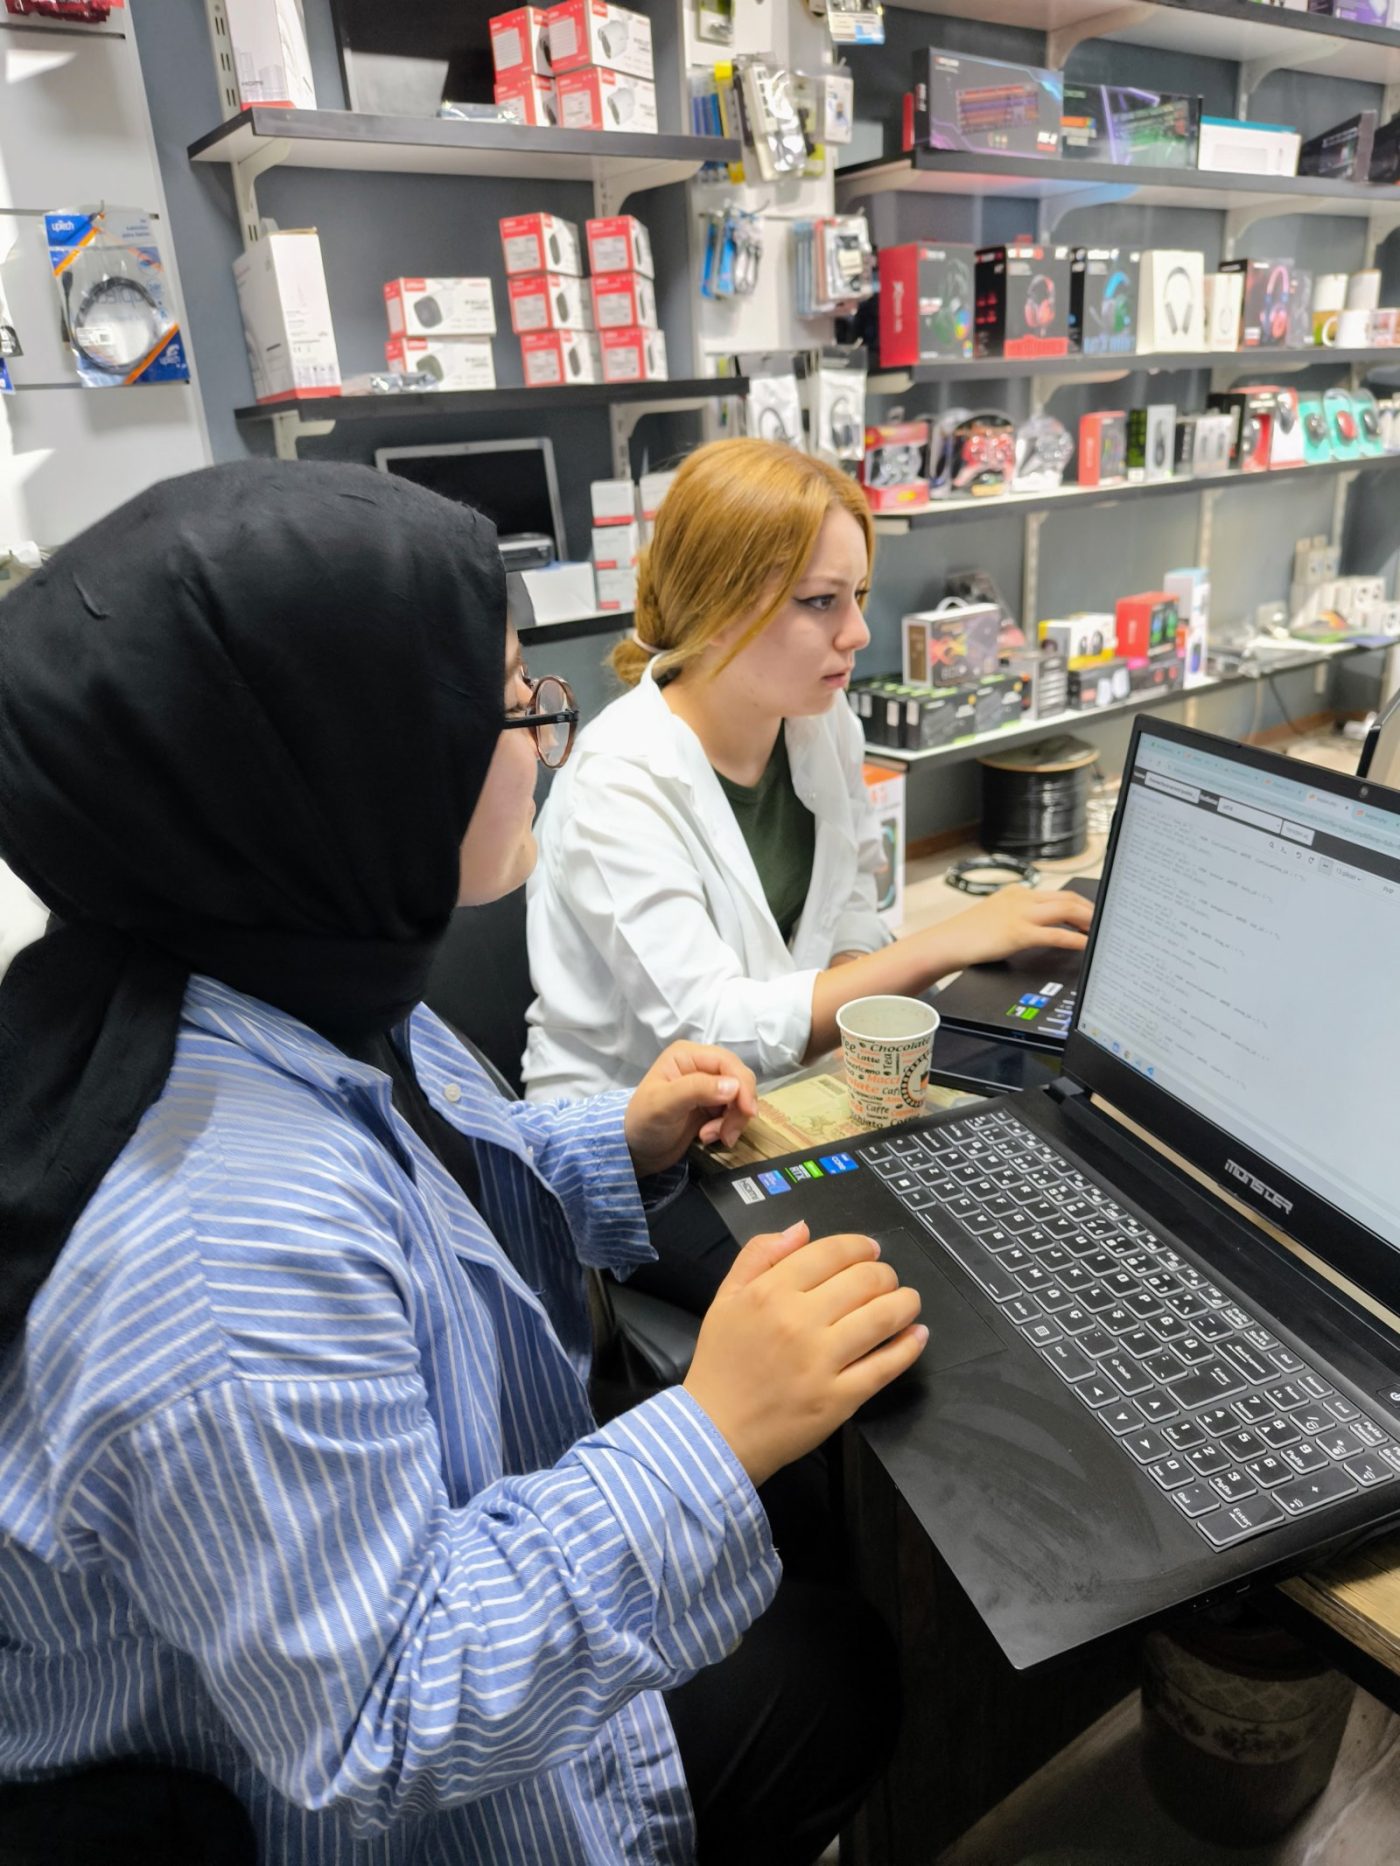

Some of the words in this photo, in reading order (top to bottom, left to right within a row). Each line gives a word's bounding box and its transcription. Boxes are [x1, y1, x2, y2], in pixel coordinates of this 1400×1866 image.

[883, 1052, 892, 1069] Tea
[987, 1155, 999, 1163] W
[943, 1182, 955, 1190] X
[1020, 1185, 1031, 1193] R
[1224, 1158, 1294, 1215] MONSTER
[959, 1198, 970, 1206] C
[1013, 1214, 1025, 1222] G
[992, 1231, 1004, 1239] B
[1031, 1231, 1043, 1239] H
[1075, 1235, 1087, 1244] U
[1010, 1249, 1023, 1258] N
[1029, 1268, 1042, 1278] M
[1069, 1268, 1082, 1277] K
[1090, 1288, 1100, 1296] L
[1138, 1294, 1151, 1302] P
[1213, 1367, 1231, 1384] Enter
[1248, 1395, 1260, 1403] 7
[1214, 1410, 1225, 1418] 4
[1272, 1419, 1286, 1429] 8
[1237, 1432, 1251, 1442] 5
[1202, 1446, 1216, 1456] 2
[1299, 1444, 1312, 1454] 9
[1166, 1459, 1180, 1470] 0
[1263, 1457, 1277, 1467] 6
[1227, 1471, 1241, 1481] 3
[1232, 1507, 1252, 1528] Enter
